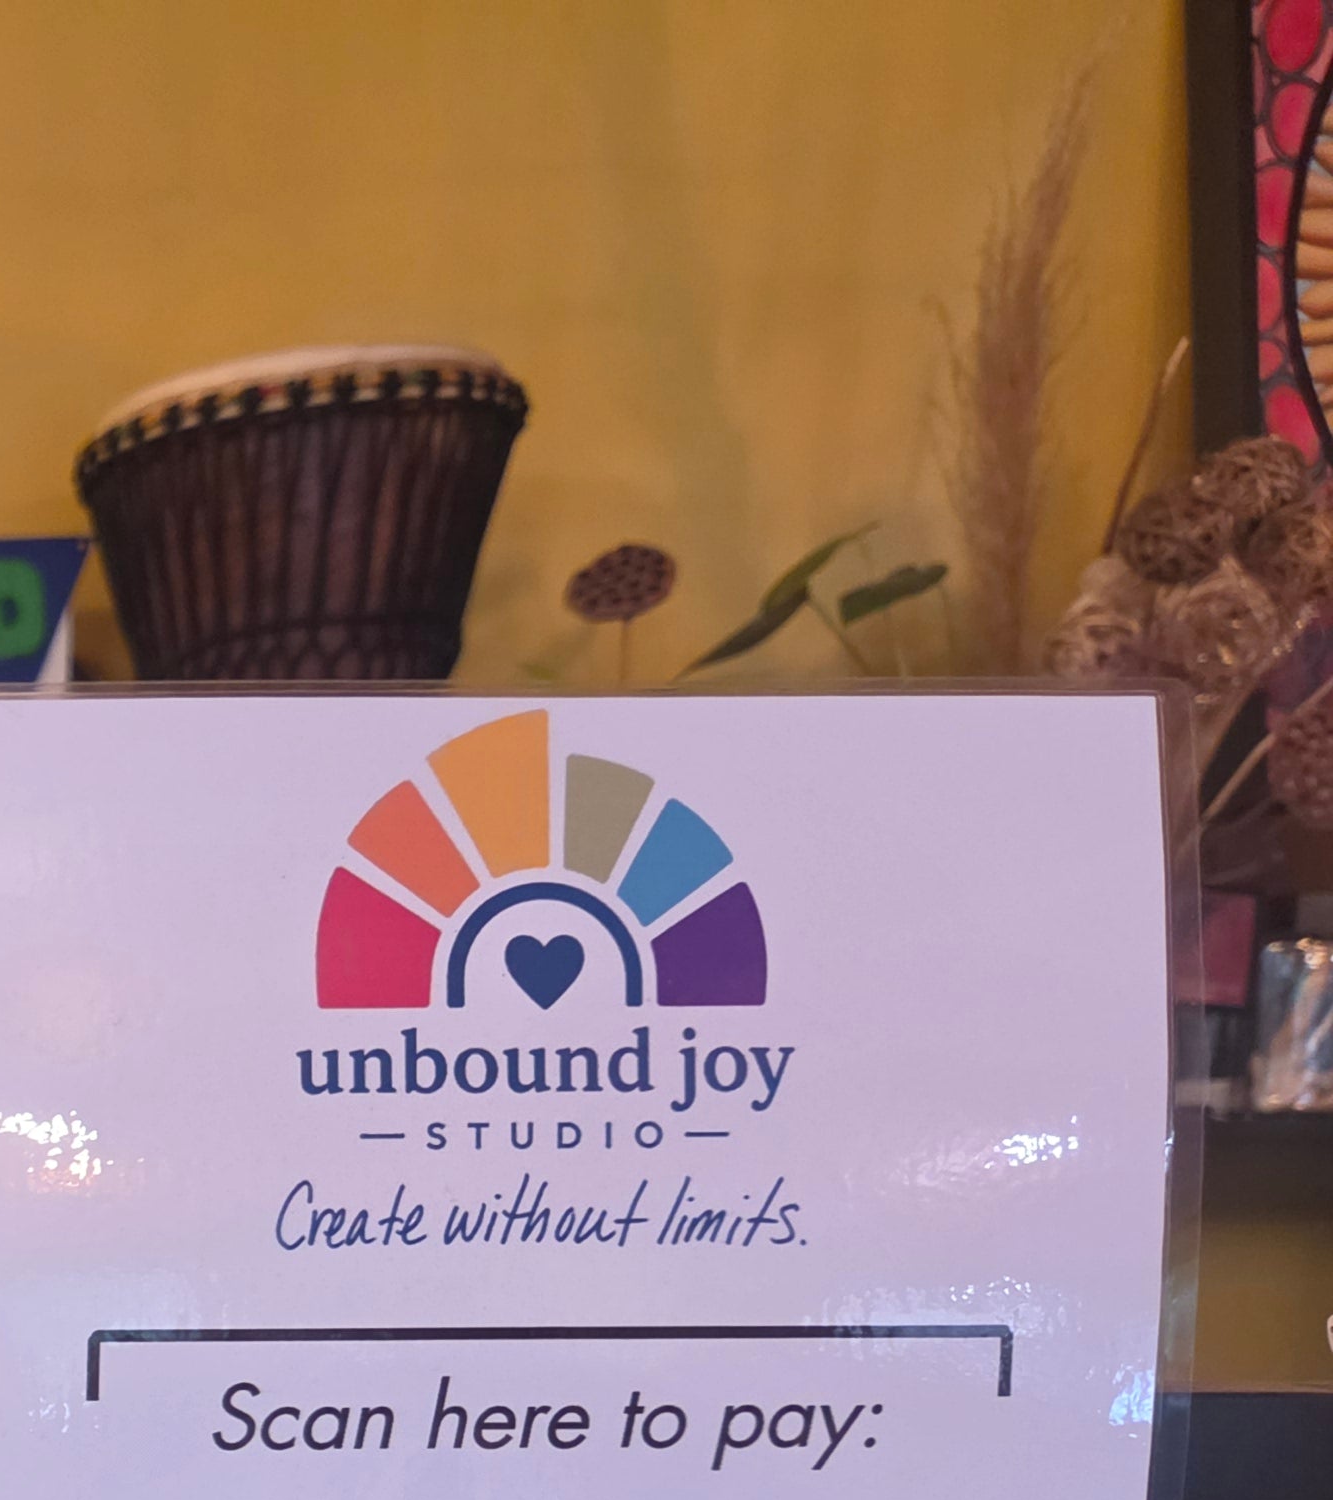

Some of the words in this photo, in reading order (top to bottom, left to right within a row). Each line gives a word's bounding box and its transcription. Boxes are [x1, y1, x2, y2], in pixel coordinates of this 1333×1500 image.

[296, 1028, 653, 1096] unbound
[671, 1026, 795, 1110] joy
[426, 1121, 664, 1150] STUDIO
[275, 1180, 428, 1252] Create
[443, 1175, 650, 1246] without
[656, 1177, 809, 1249] limits.
[213, 1383, 395, 1450] Scan
[426, 1378, 591, 1450] here
[617, 1391, 688, 1450] to
[713, 1396, 884, 1471] pay:
